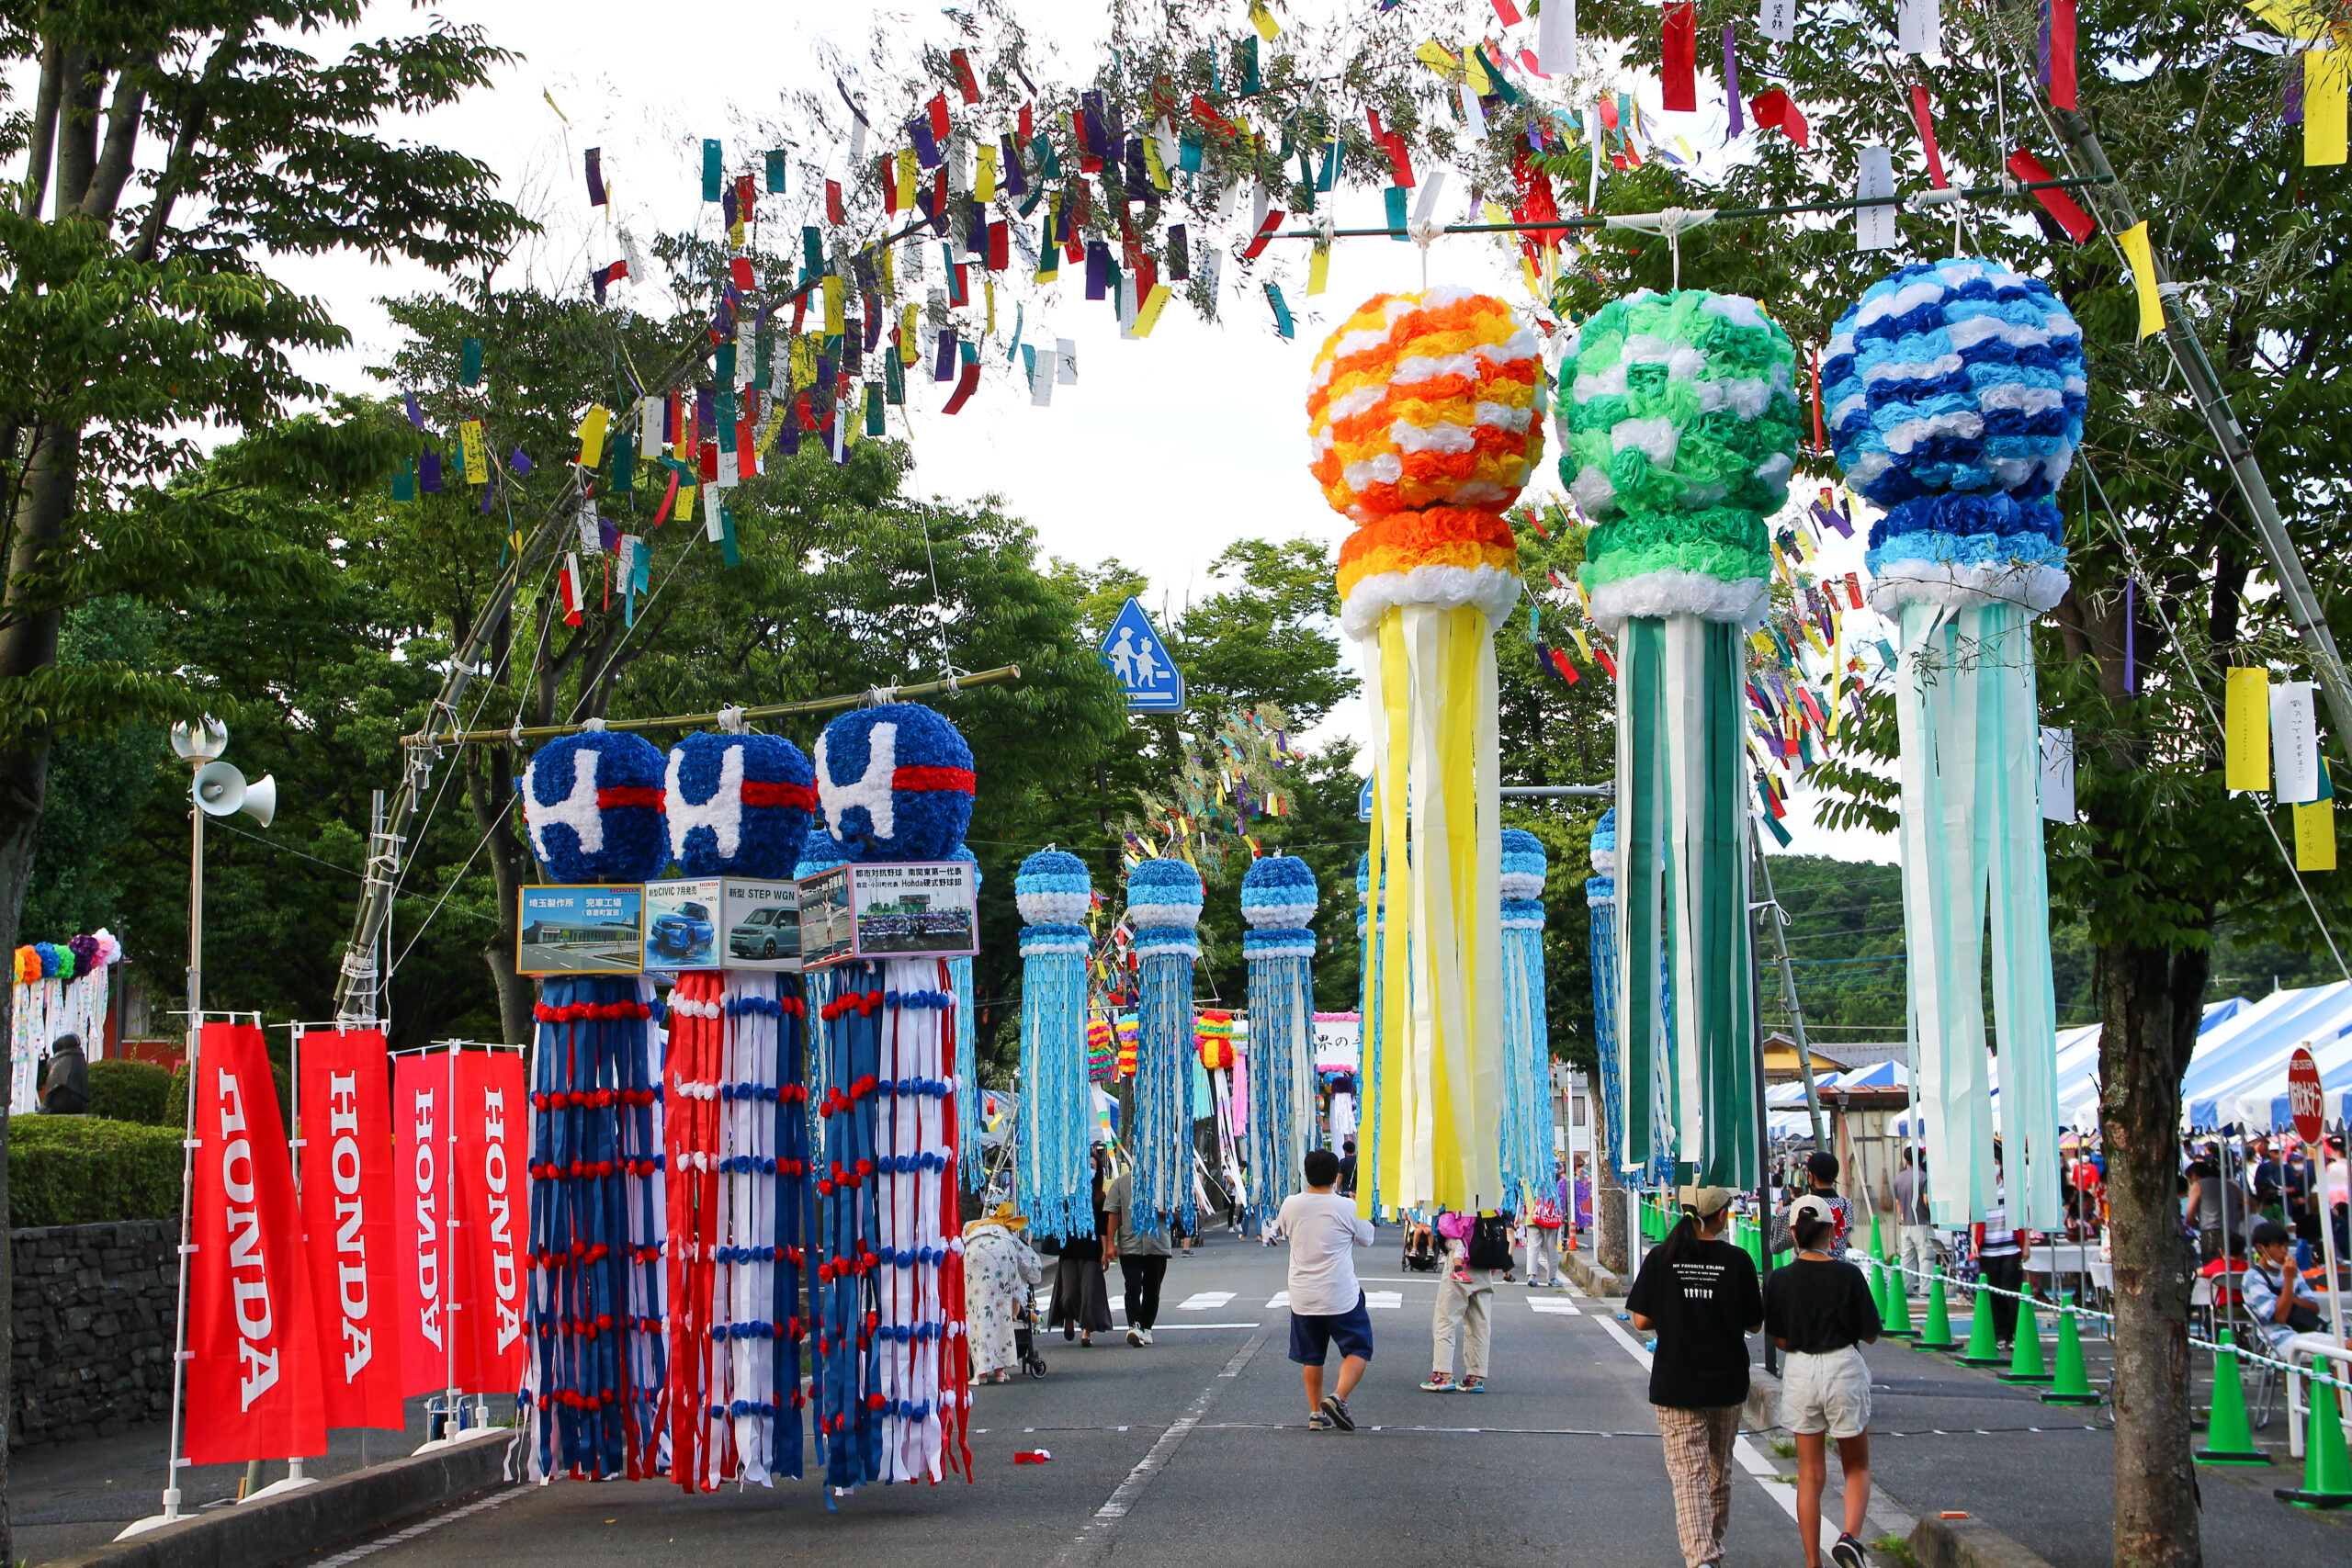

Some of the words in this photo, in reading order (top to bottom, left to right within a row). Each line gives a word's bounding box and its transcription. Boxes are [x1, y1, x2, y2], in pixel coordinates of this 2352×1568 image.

[529, 898, 574, 908] 埼玉製作所
[729, 887, 745, 898] 新型
[748, 889, 771, 899] STEP
[773, 890, 796, 901] WGN
[855, 869, 902, 877] 都市対抗野球
[908, 867, 962, 876] 南関東第一代表
[218, 1066, 279, 1413] HONDA
[330, 1069, 372, 1384] HONDA
[483, 1086, 521, 1356] HONDA
